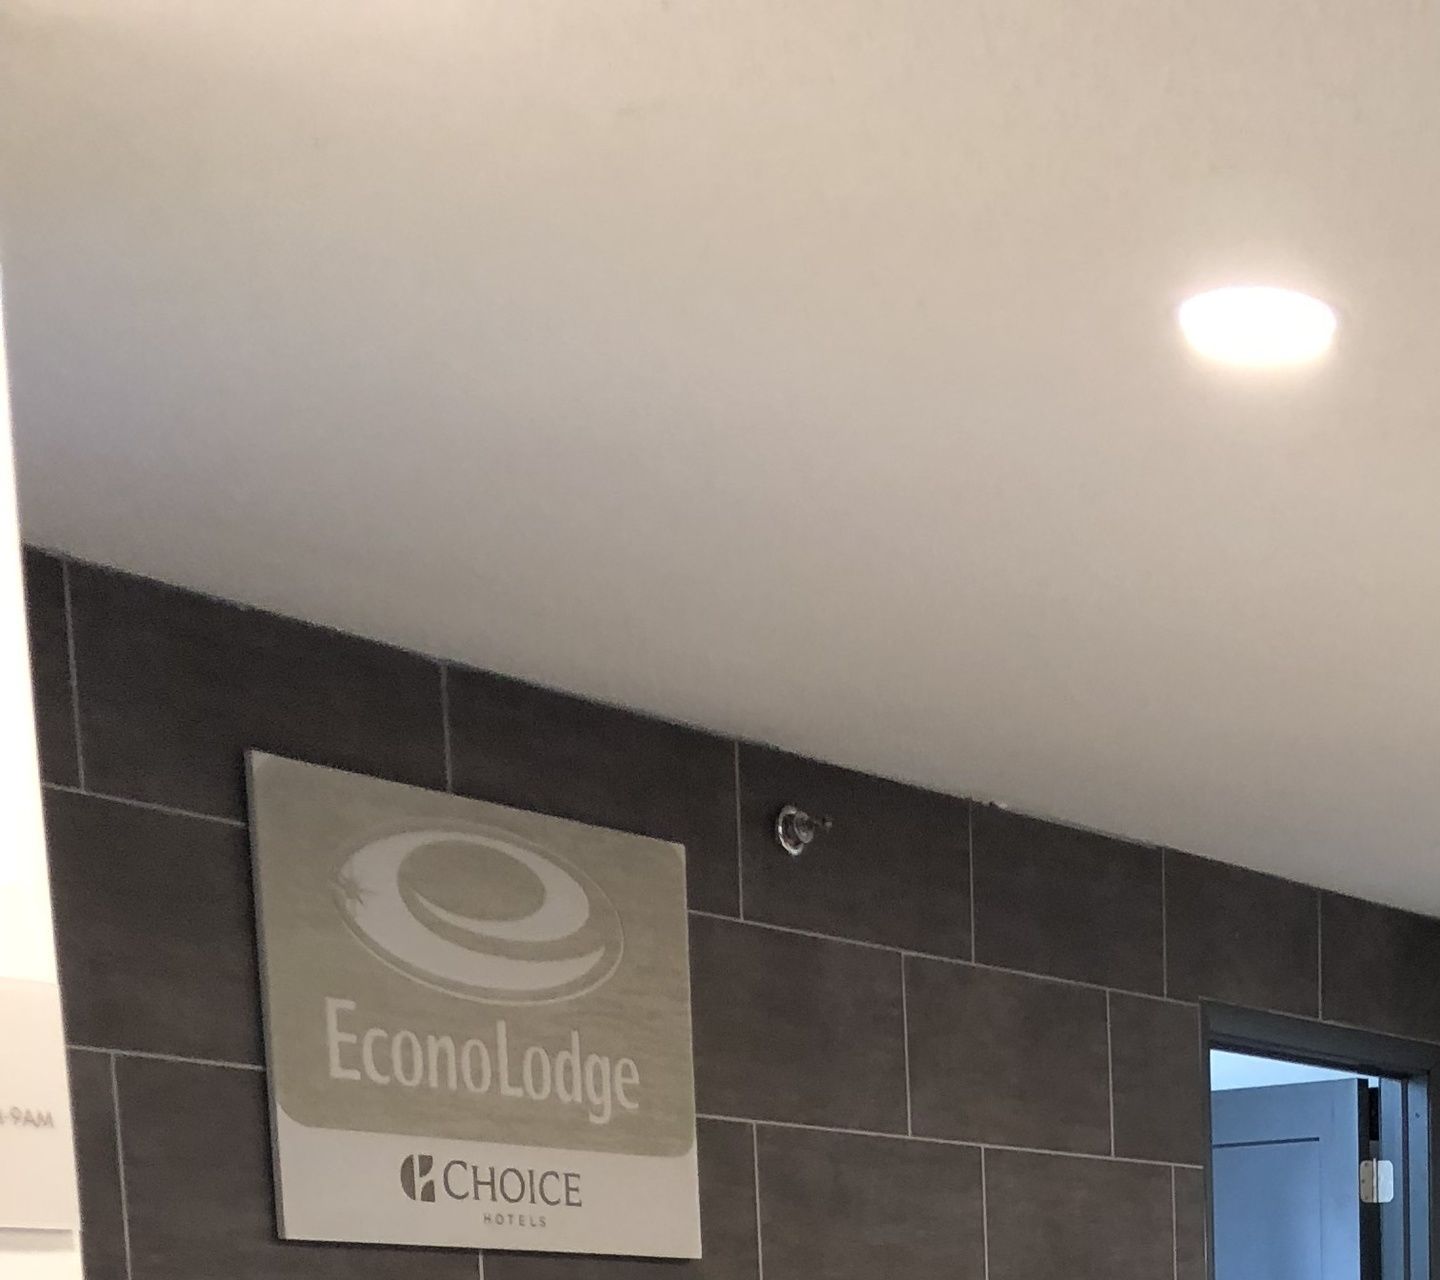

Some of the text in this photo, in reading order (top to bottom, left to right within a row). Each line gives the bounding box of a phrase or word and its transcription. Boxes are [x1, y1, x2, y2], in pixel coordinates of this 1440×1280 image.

[324, 996, 640, 1124] EconoLodge
[443, 1160, 582, 1207] CHOICE
[483, 1213, 547, 1228] HOTELS
